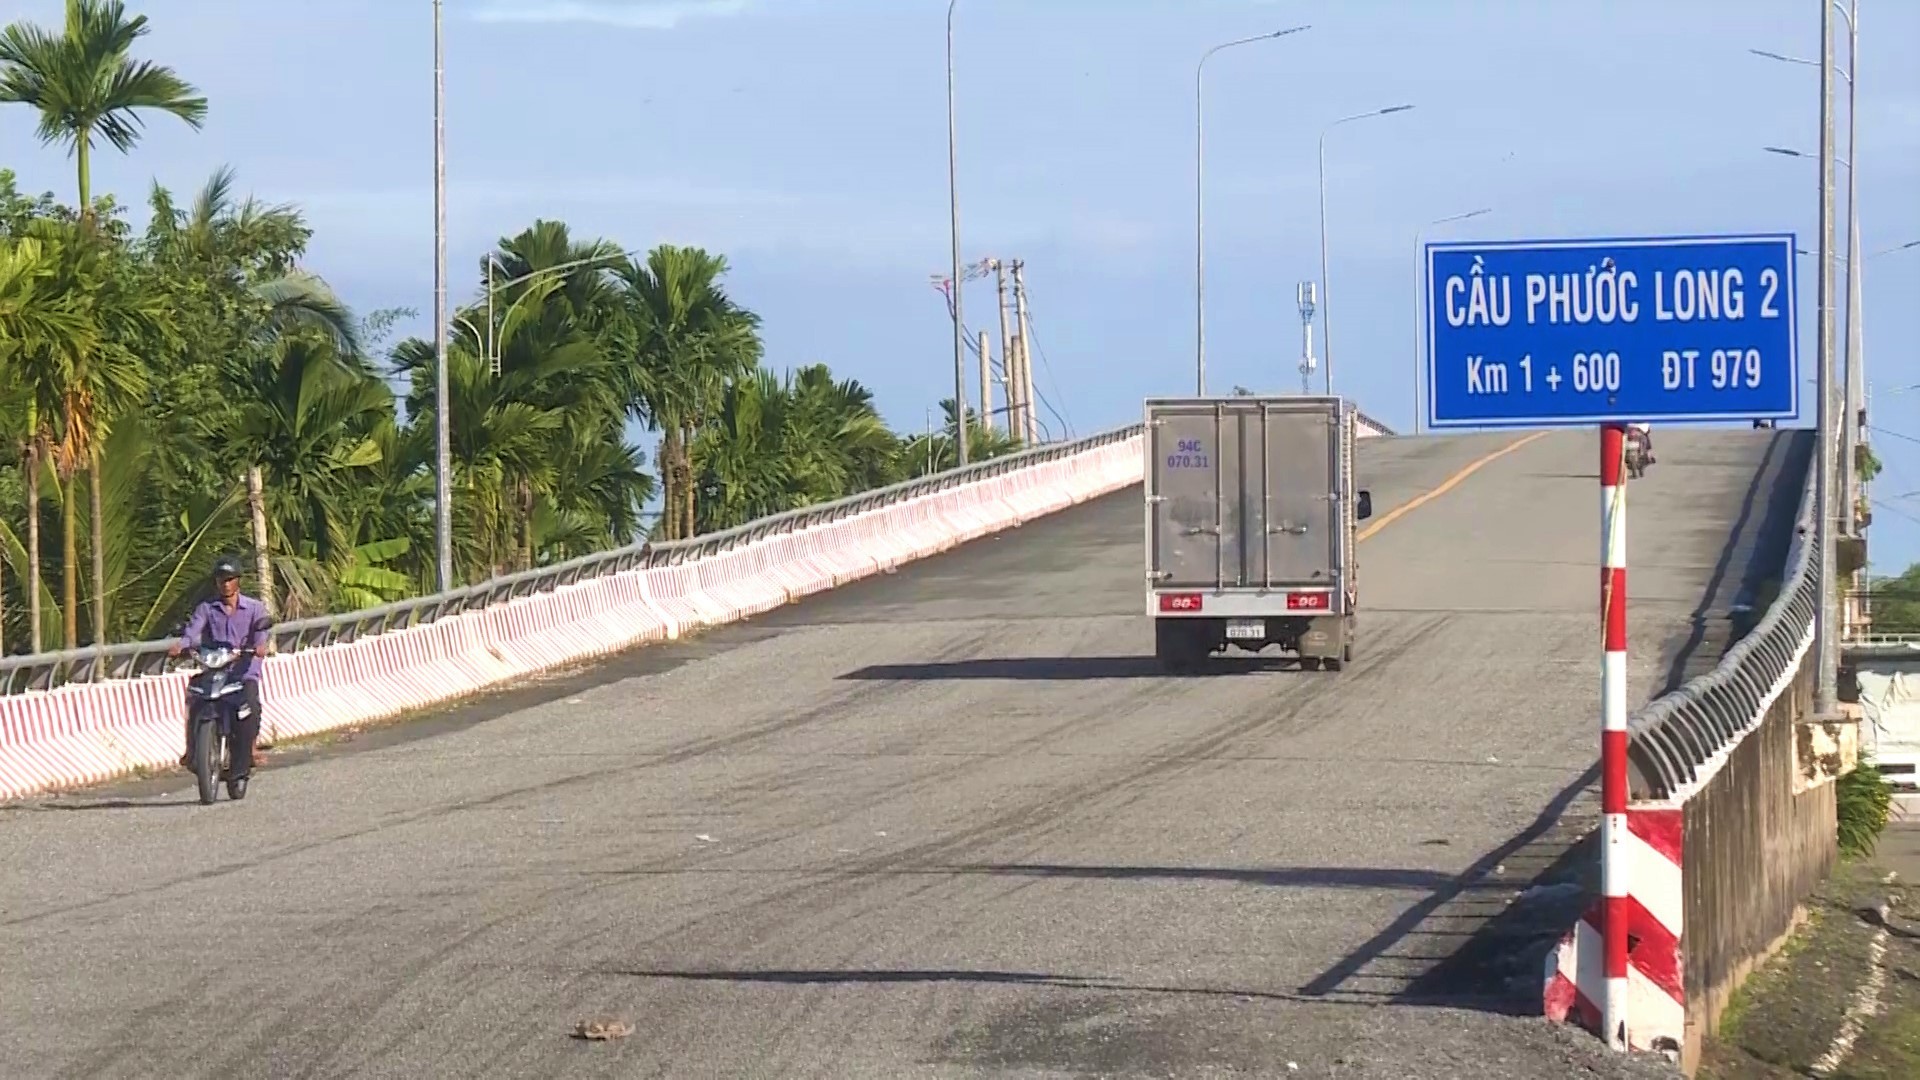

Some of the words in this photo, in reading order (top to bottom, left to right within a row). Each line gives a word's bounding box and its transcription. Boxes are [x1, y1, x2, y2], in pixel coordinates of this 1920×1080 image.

[1446, 255, 1511, 327] CẦU
[1526, 257, 1639, 323] PHƯỚC
[1655, 269, 1744, 321] LONG
[1760, 269, 1779, 319] 2
[1467, 356, 1508, 394] Km
[1519, 355, 1532, 392] 1
[1546, 367, 1562, 391] +
[1573, 353, 1620, 392] 600
[1662, 351, 1699, 389] ĐT
[1711, 349, 1761, 388] 979
[1178, 439, 1202, 452] 94C
[1167, 455, 1209, 468] 070.31
